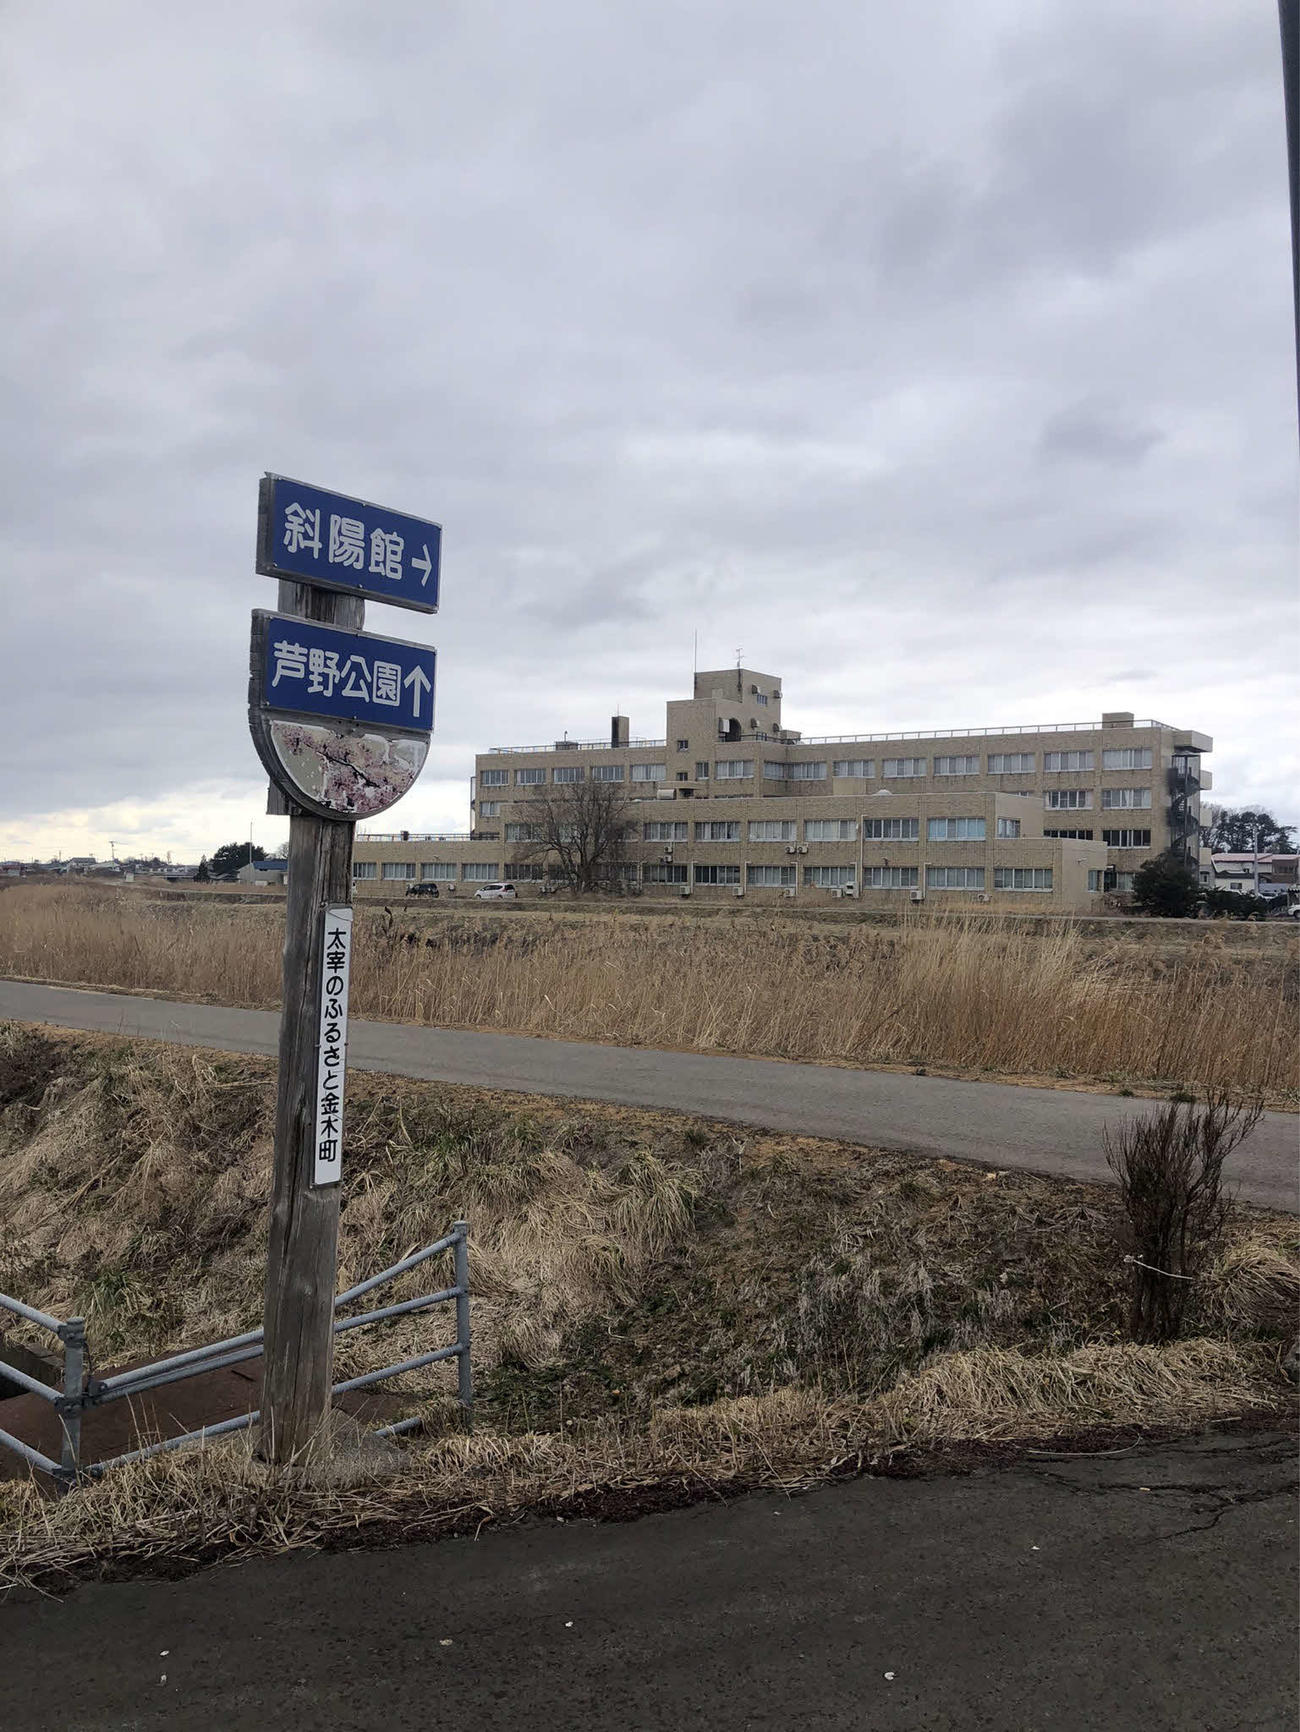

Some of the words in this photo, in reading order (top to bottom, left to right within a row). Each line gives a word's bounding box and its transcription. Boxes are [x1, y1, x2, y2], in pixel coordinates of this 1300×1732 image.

[284, 502, 404, 580] 斜陽館
[271, 639, 401, 707] 芦野公園
[318, 927, 347, 1163] 太宰のふるさと金木町
